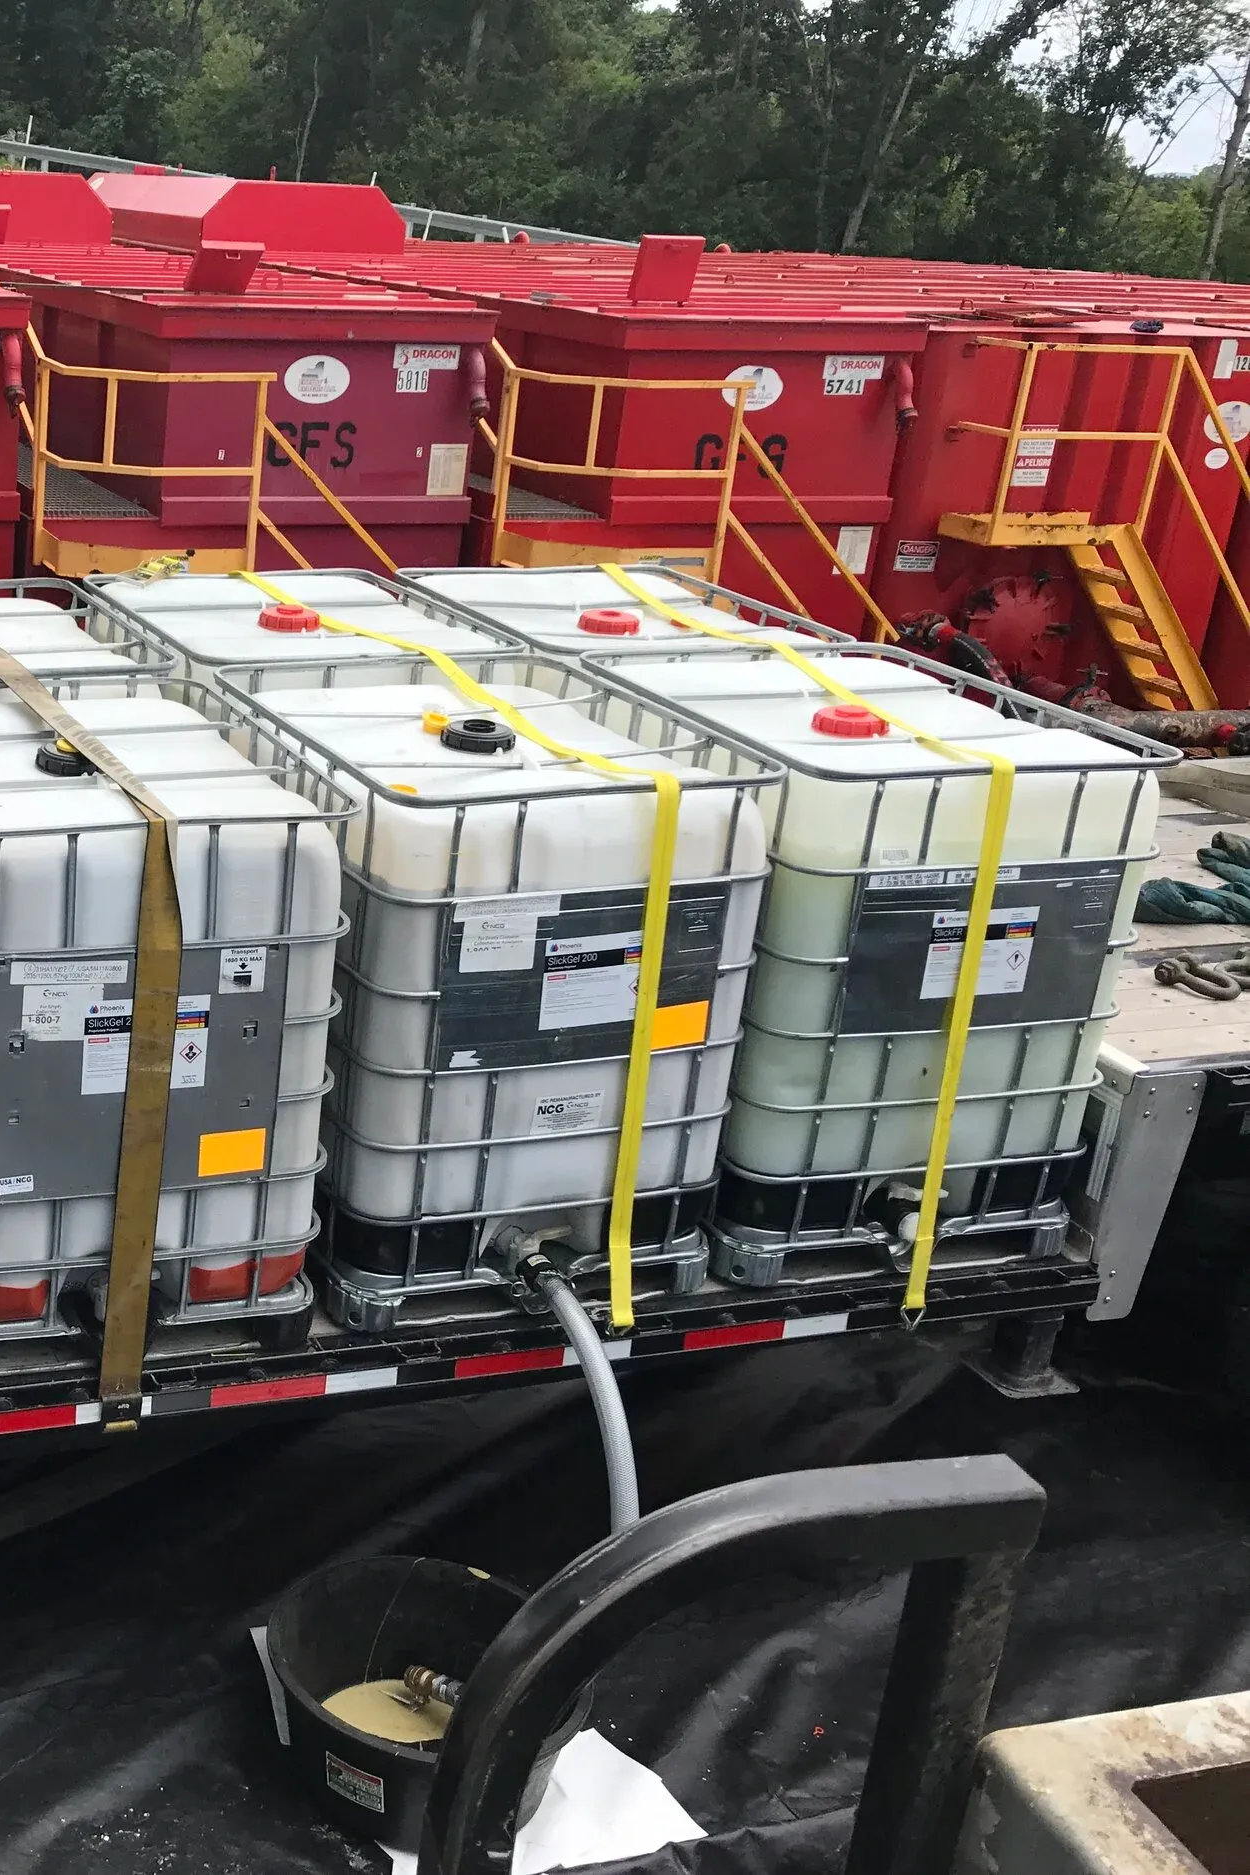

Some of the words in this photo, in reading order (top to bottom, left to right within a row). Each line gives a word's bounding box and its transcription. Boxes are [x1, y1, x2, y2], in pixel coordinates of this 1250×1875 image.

[412, 349, 457, 359] DRAGON
[841, 360, 881, 370] DRAGON
[397, 370, 428, 391] 5816
[826, 379, 862, 394] 5741
[903, 545, 934, 554] DANGER
[934, 928, 963, 937] SlickFR
[548, 955, 580, 966] SlickGel
[582, 953, 598, 962] 200
[88, 1018, 124, 1028] SlickGel
[537, 1103, 564, 1115] NCG
